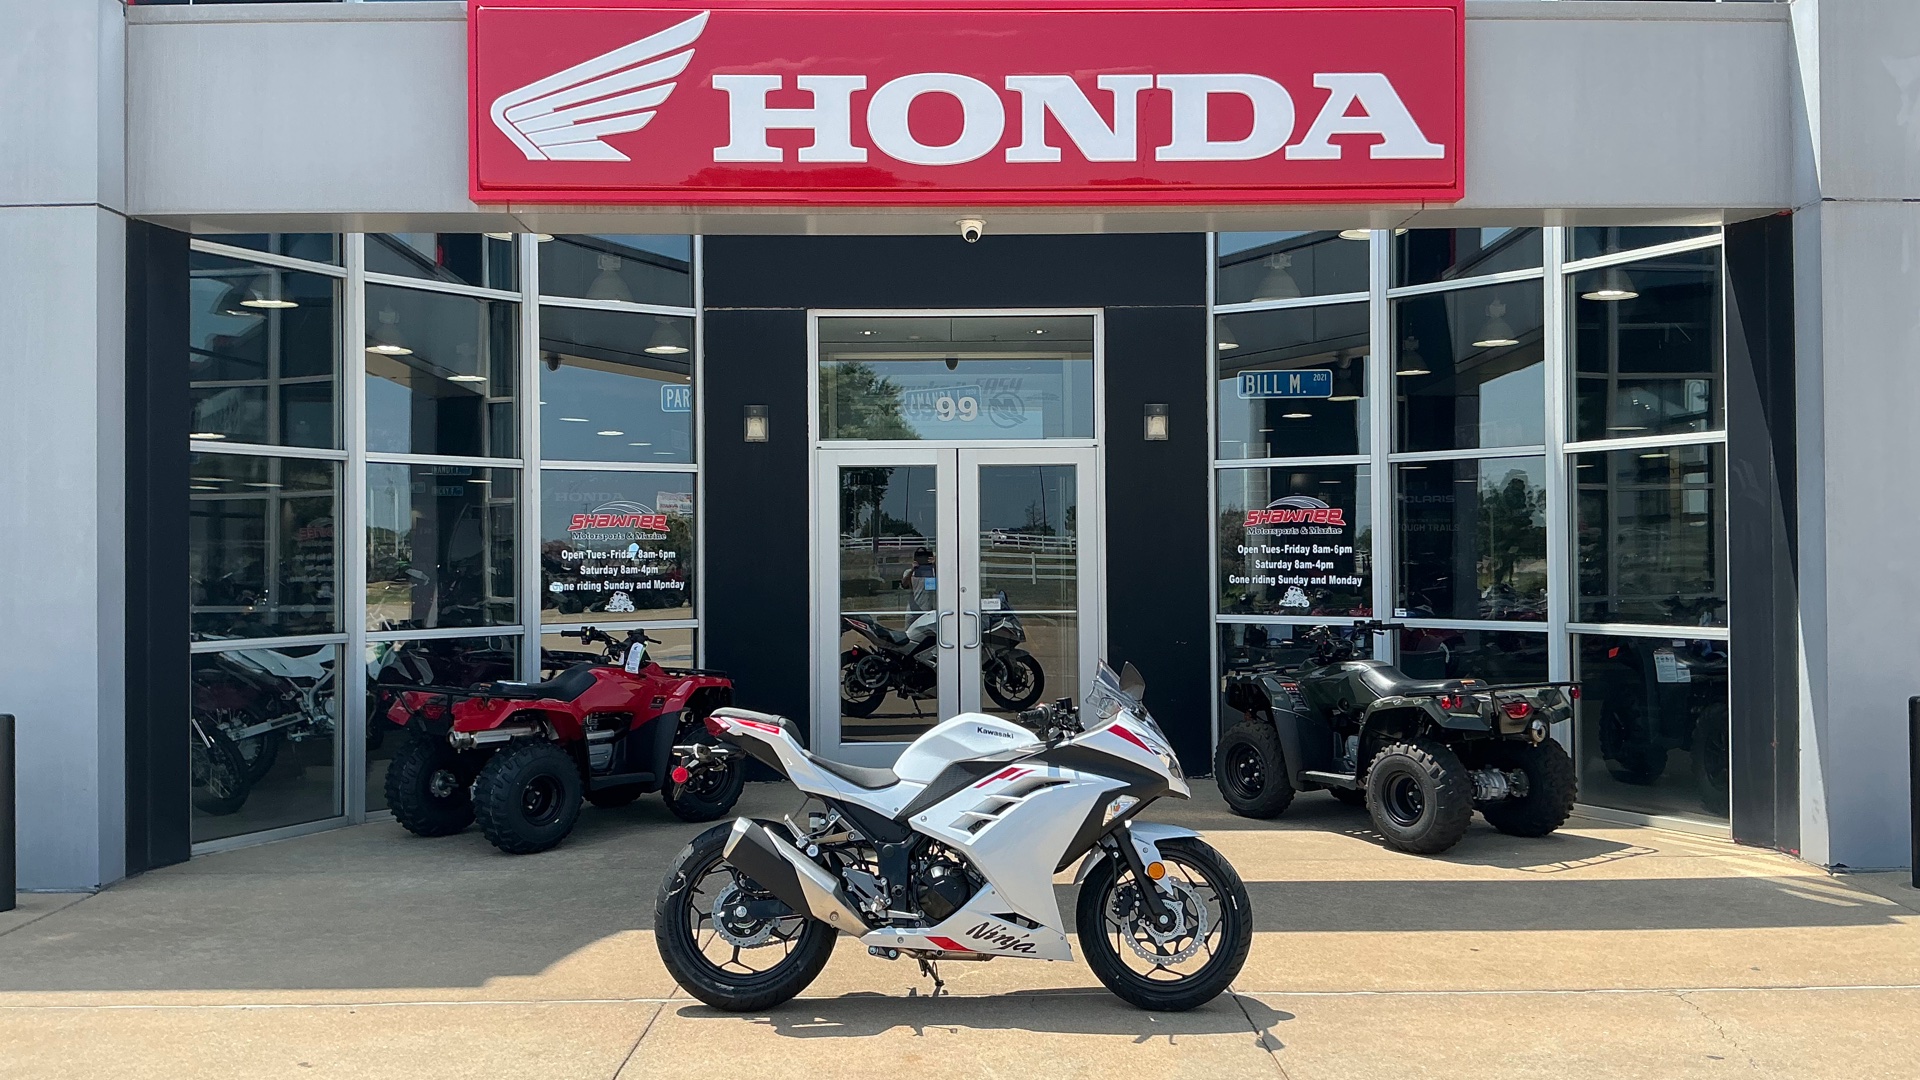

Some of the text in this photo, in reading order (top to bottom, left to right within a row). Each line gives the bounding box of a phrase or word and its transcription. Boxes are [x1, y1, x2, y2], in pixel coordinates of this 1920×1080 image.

[711, 73, 1445, 164] HONDA
[1313, 373, 1327, 382] 2021
[1245, 373, 1307, 395] BILL M.
[666, 388, 690, 408] PAR
[936, 397, 978, 422] 99
[554, 492, 625, 502] HONDA
[1247, 526, 1342, 537] Motorsports & Marine
[1399, 523, 1460, 532] OUGH TRAILS
[572, 531, 667, 542] Motorsports & Marine
[561, 550, 584, 561] Open
[638, 549, 676, 560] 8am-6pm
[1237, 544, 1353, 556] Open Tues-Friday 8am-6pm
[580, 564, 659, 576] Saturday 8am-4pm
[1255, 560, 1334, 571] Saturday 8am-4pm
[576, 581, 602, 592] riding
[603, 580, 634, 592] Sunday
[636, 579, 652, 590] and
[653, 578, 685, 591] Monday
[1229, 574, 1362, 587] Gone riding Sunday and Monday
[977, 726, 1014, 739] Kawasaki
[965, 921, 1037, 954] Ninja
